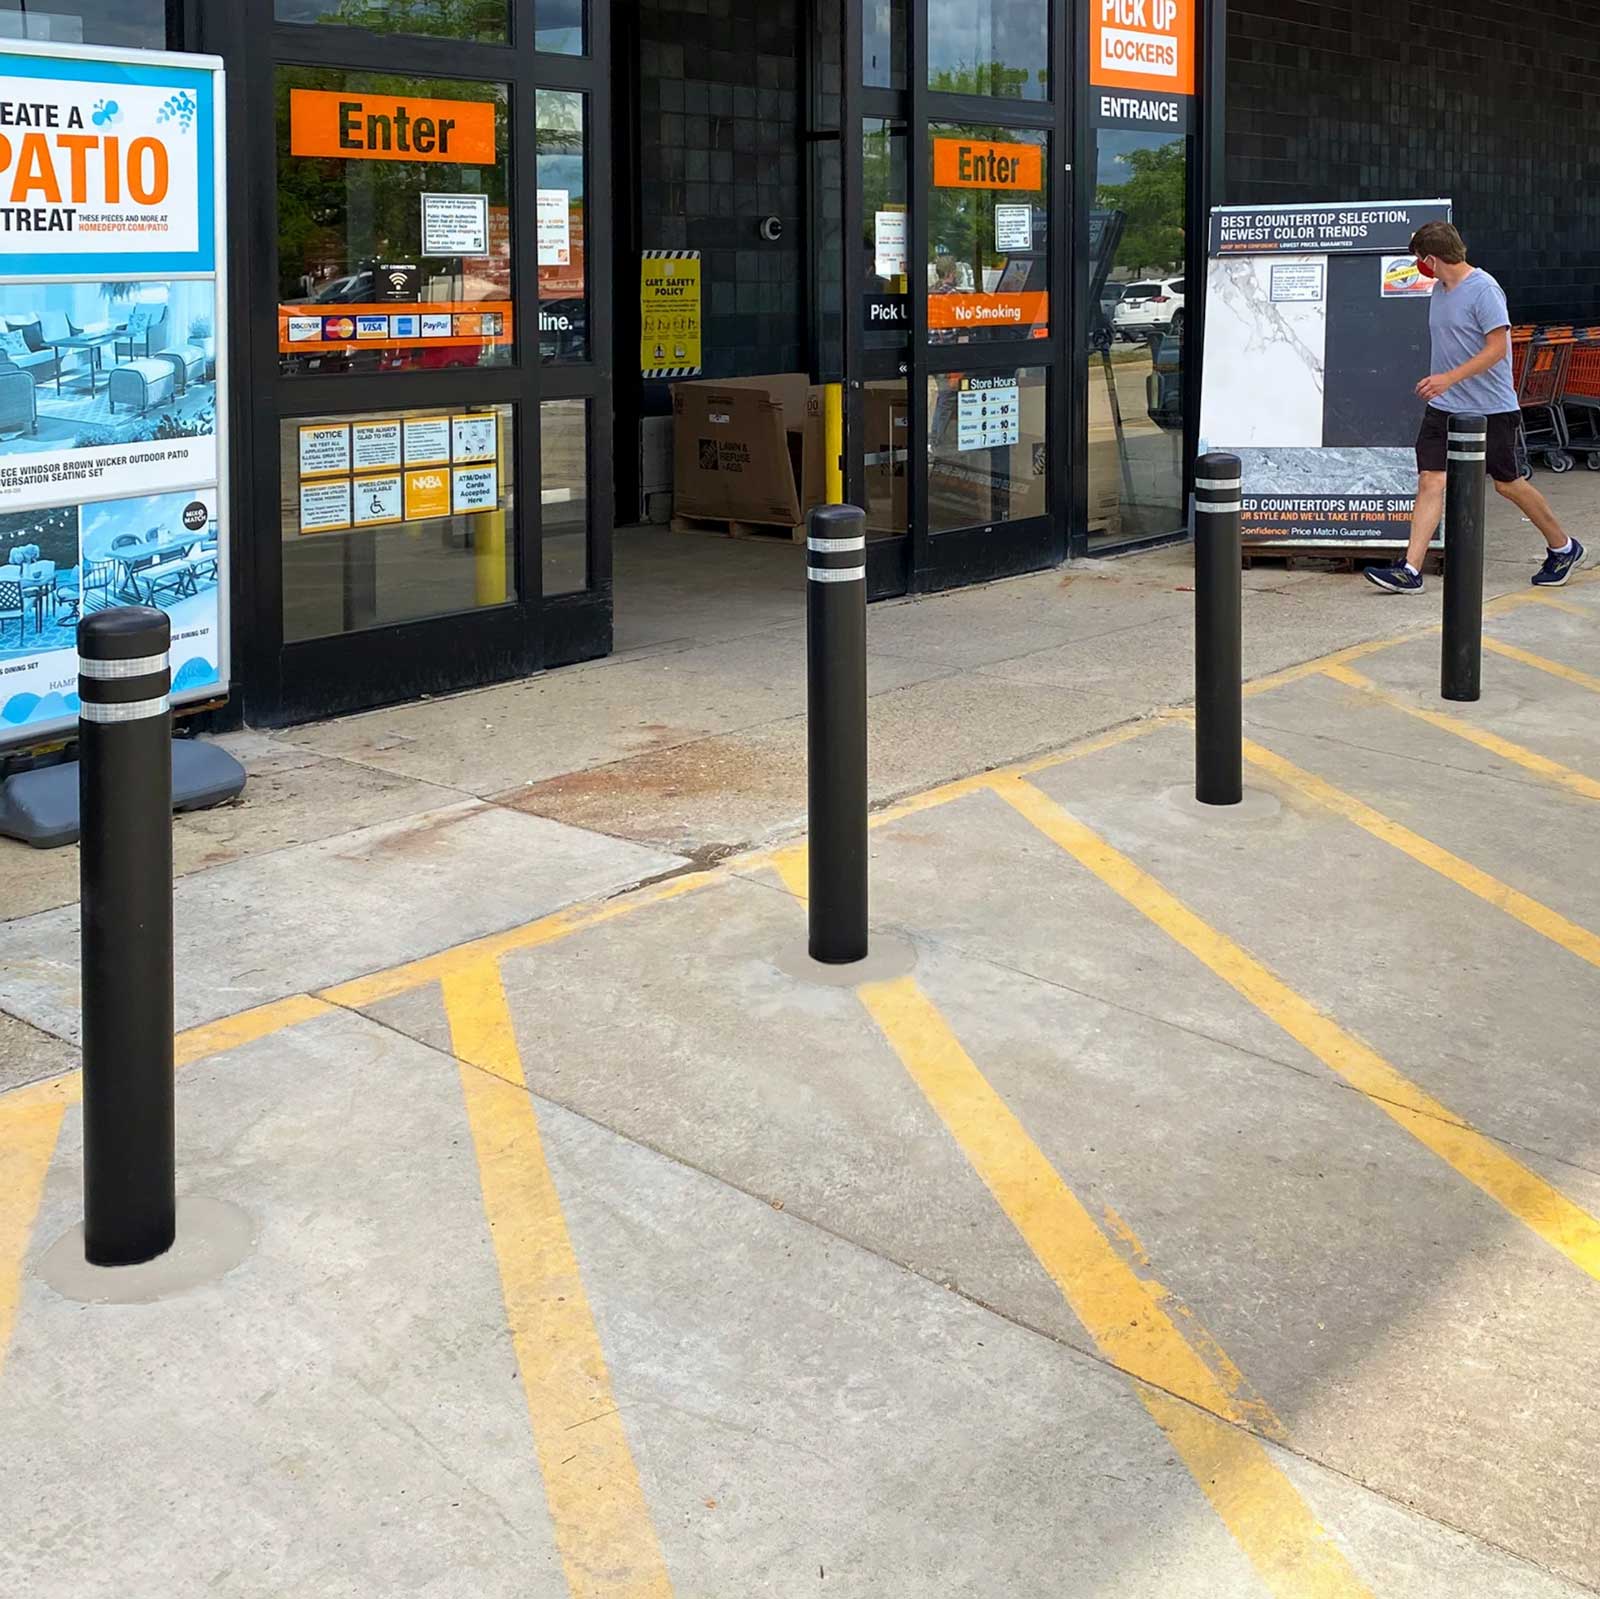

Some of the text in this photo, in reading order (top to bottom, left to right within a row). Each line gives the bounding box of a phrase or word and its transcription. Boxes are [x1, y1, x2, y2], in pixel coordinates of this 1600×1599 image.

[1102, 0, 1177, 31] PICK UP
[1105, 38, 1174, 65] LOCKERS
[0, 102, 84, 129] EATE A
[1100, 96, 1178, 122] ENTRANCE
[339, 101, 455, 153] Enter
[958, 146, 1020, 183] Enter
[0, 208, 76, 232] TREAT
[79, 214, 99, 222] THESE
[101, 214, 124, 222] PIECES
[1221, 210, 1410, 228] BEST COUNTERTOP SELECTION,
[79, 223, 168, 232] HOMEDEPOT.COM/PATIO
[1220, 224, 1368, 241] NEWEST COLOR TRENDS
[666, 278, 695, 287] SAFETY
[655, 287, 684, 296] POLICY
[870, 303, 898, 320] Pick
[955, 304, 1021, 320] No Smoking
[291, 321, 320, 330] DISCOVER
[362, 322, 382, 332] VISA
[423, 320, 449, 331] PayPal
[538, 311, 573, 331] line.
[970, 376, 1017, 390] Store Hours
[313, 430, 343, 440] NOTICE
[1, 449, 189, 477] ECE WINDSOR BROWN WICKER OUTDOOR PATIO
[0, 468, 104, 487] VERSATION SEATING SET
[412, 475, 443, 490] NKBA
[458, 473, 492, 482] ATM/Debit
[465, 481, 485, 489] Cards
[460, 488, 490, 498] Accepted
[468, 496, 482, 504] Here
[1240, 499, 1258, 511] ED
[1260, 499, 1345, 512] COUNTERTOPS
[1349, 499, 1383, 512] MADE
[1253, 512, 1279, 521] STYLE
[1280, 512, 1299, 521] AND
[1300, 512, 1325, 521] WE'LL
[1327, 512, 1349, 521] TAKE
[1350, 512, 1358, 521] IT
[1360, 512, 1385, 521] FROM
[1291, 527, 1311, 536] Price
[1313, 527, 1338, 536] Match
[1340, 527, 1382, 536] Guarantee
[4, 664, 26, 674] DINING
[27, 661, 39, 670] SET
